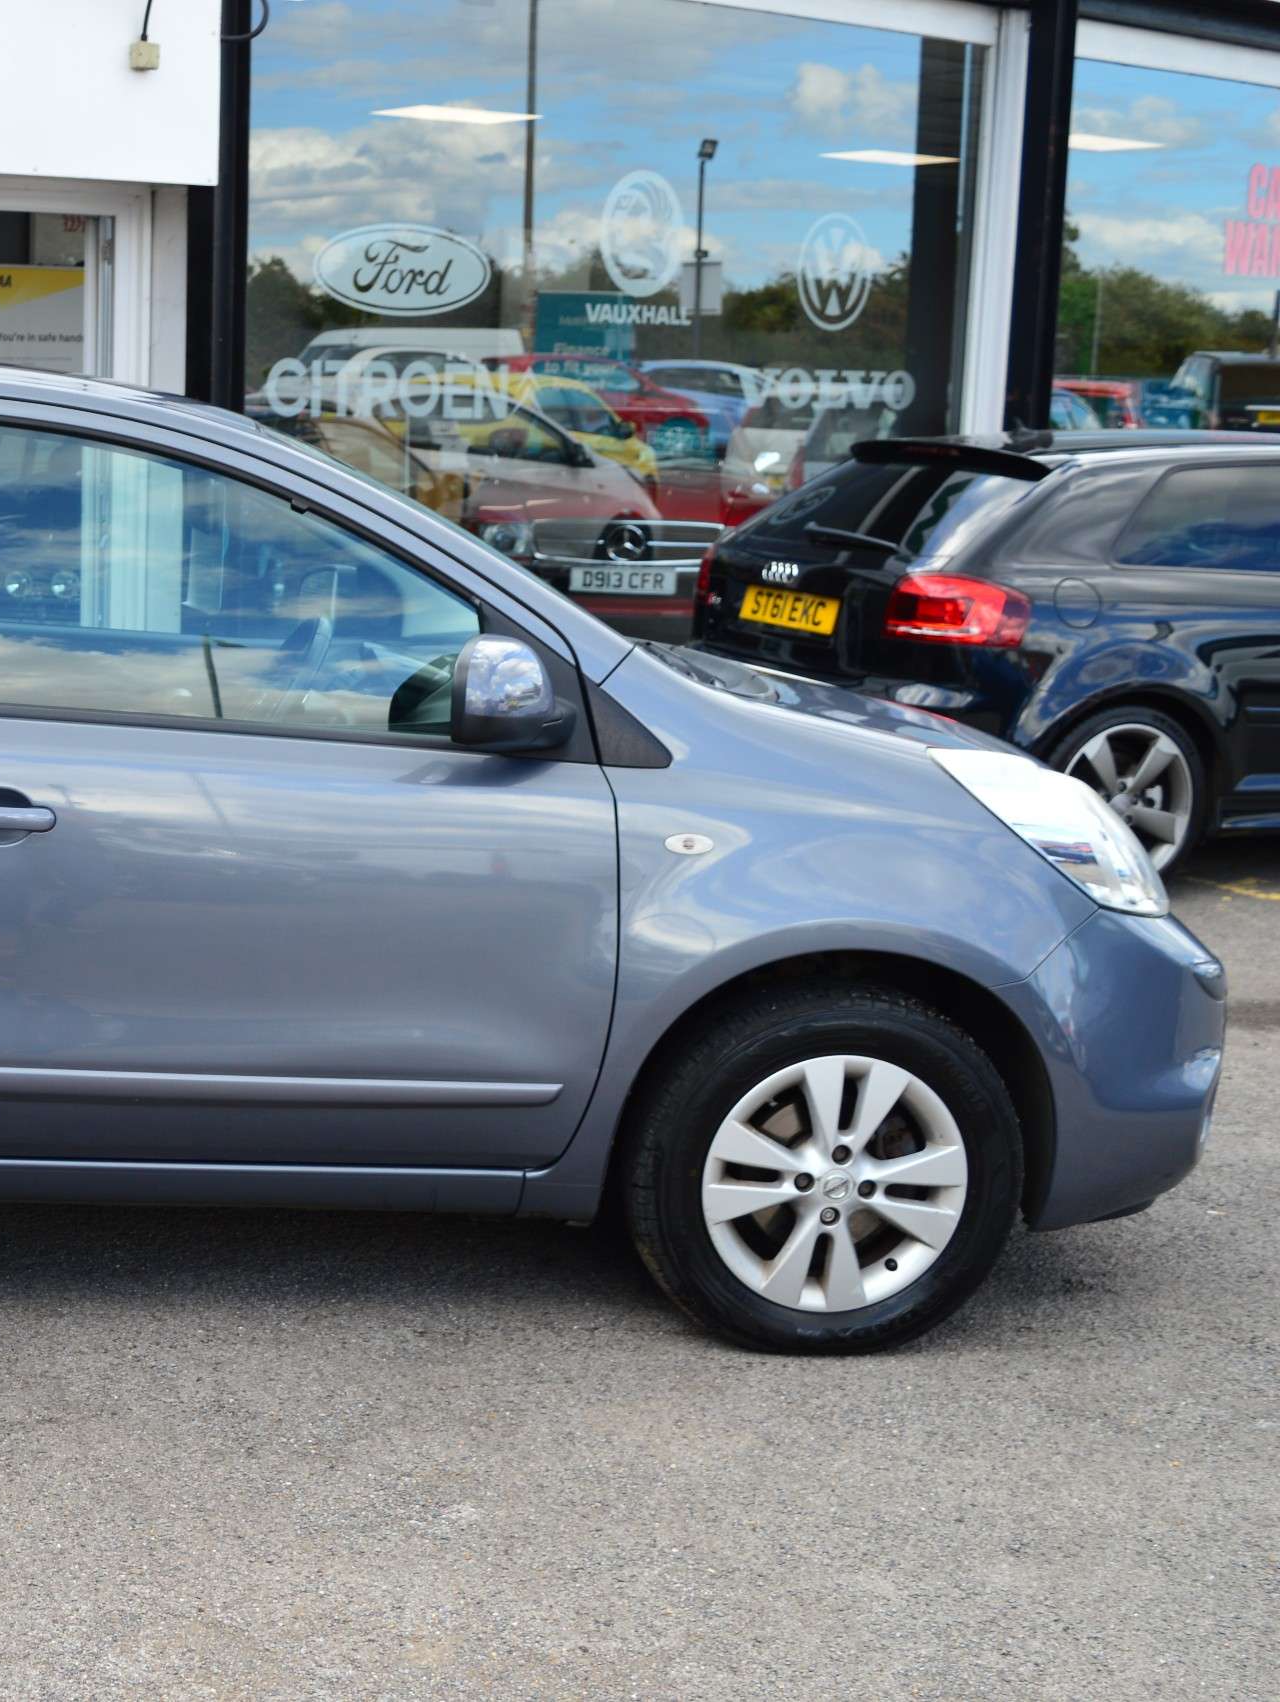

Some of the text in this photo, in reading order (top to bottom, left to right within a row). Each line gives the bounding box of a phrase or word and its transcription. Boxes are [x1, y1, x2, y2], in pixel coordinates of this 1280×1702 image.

[353, 239, 456, 296] Ford
[585, 302, 692, 326] VAUXHALL
[38, 332, 57, 342] safe
[738, 367, 916, 411] VOLVO
[582, 570, 665, 590] D913 CFR
